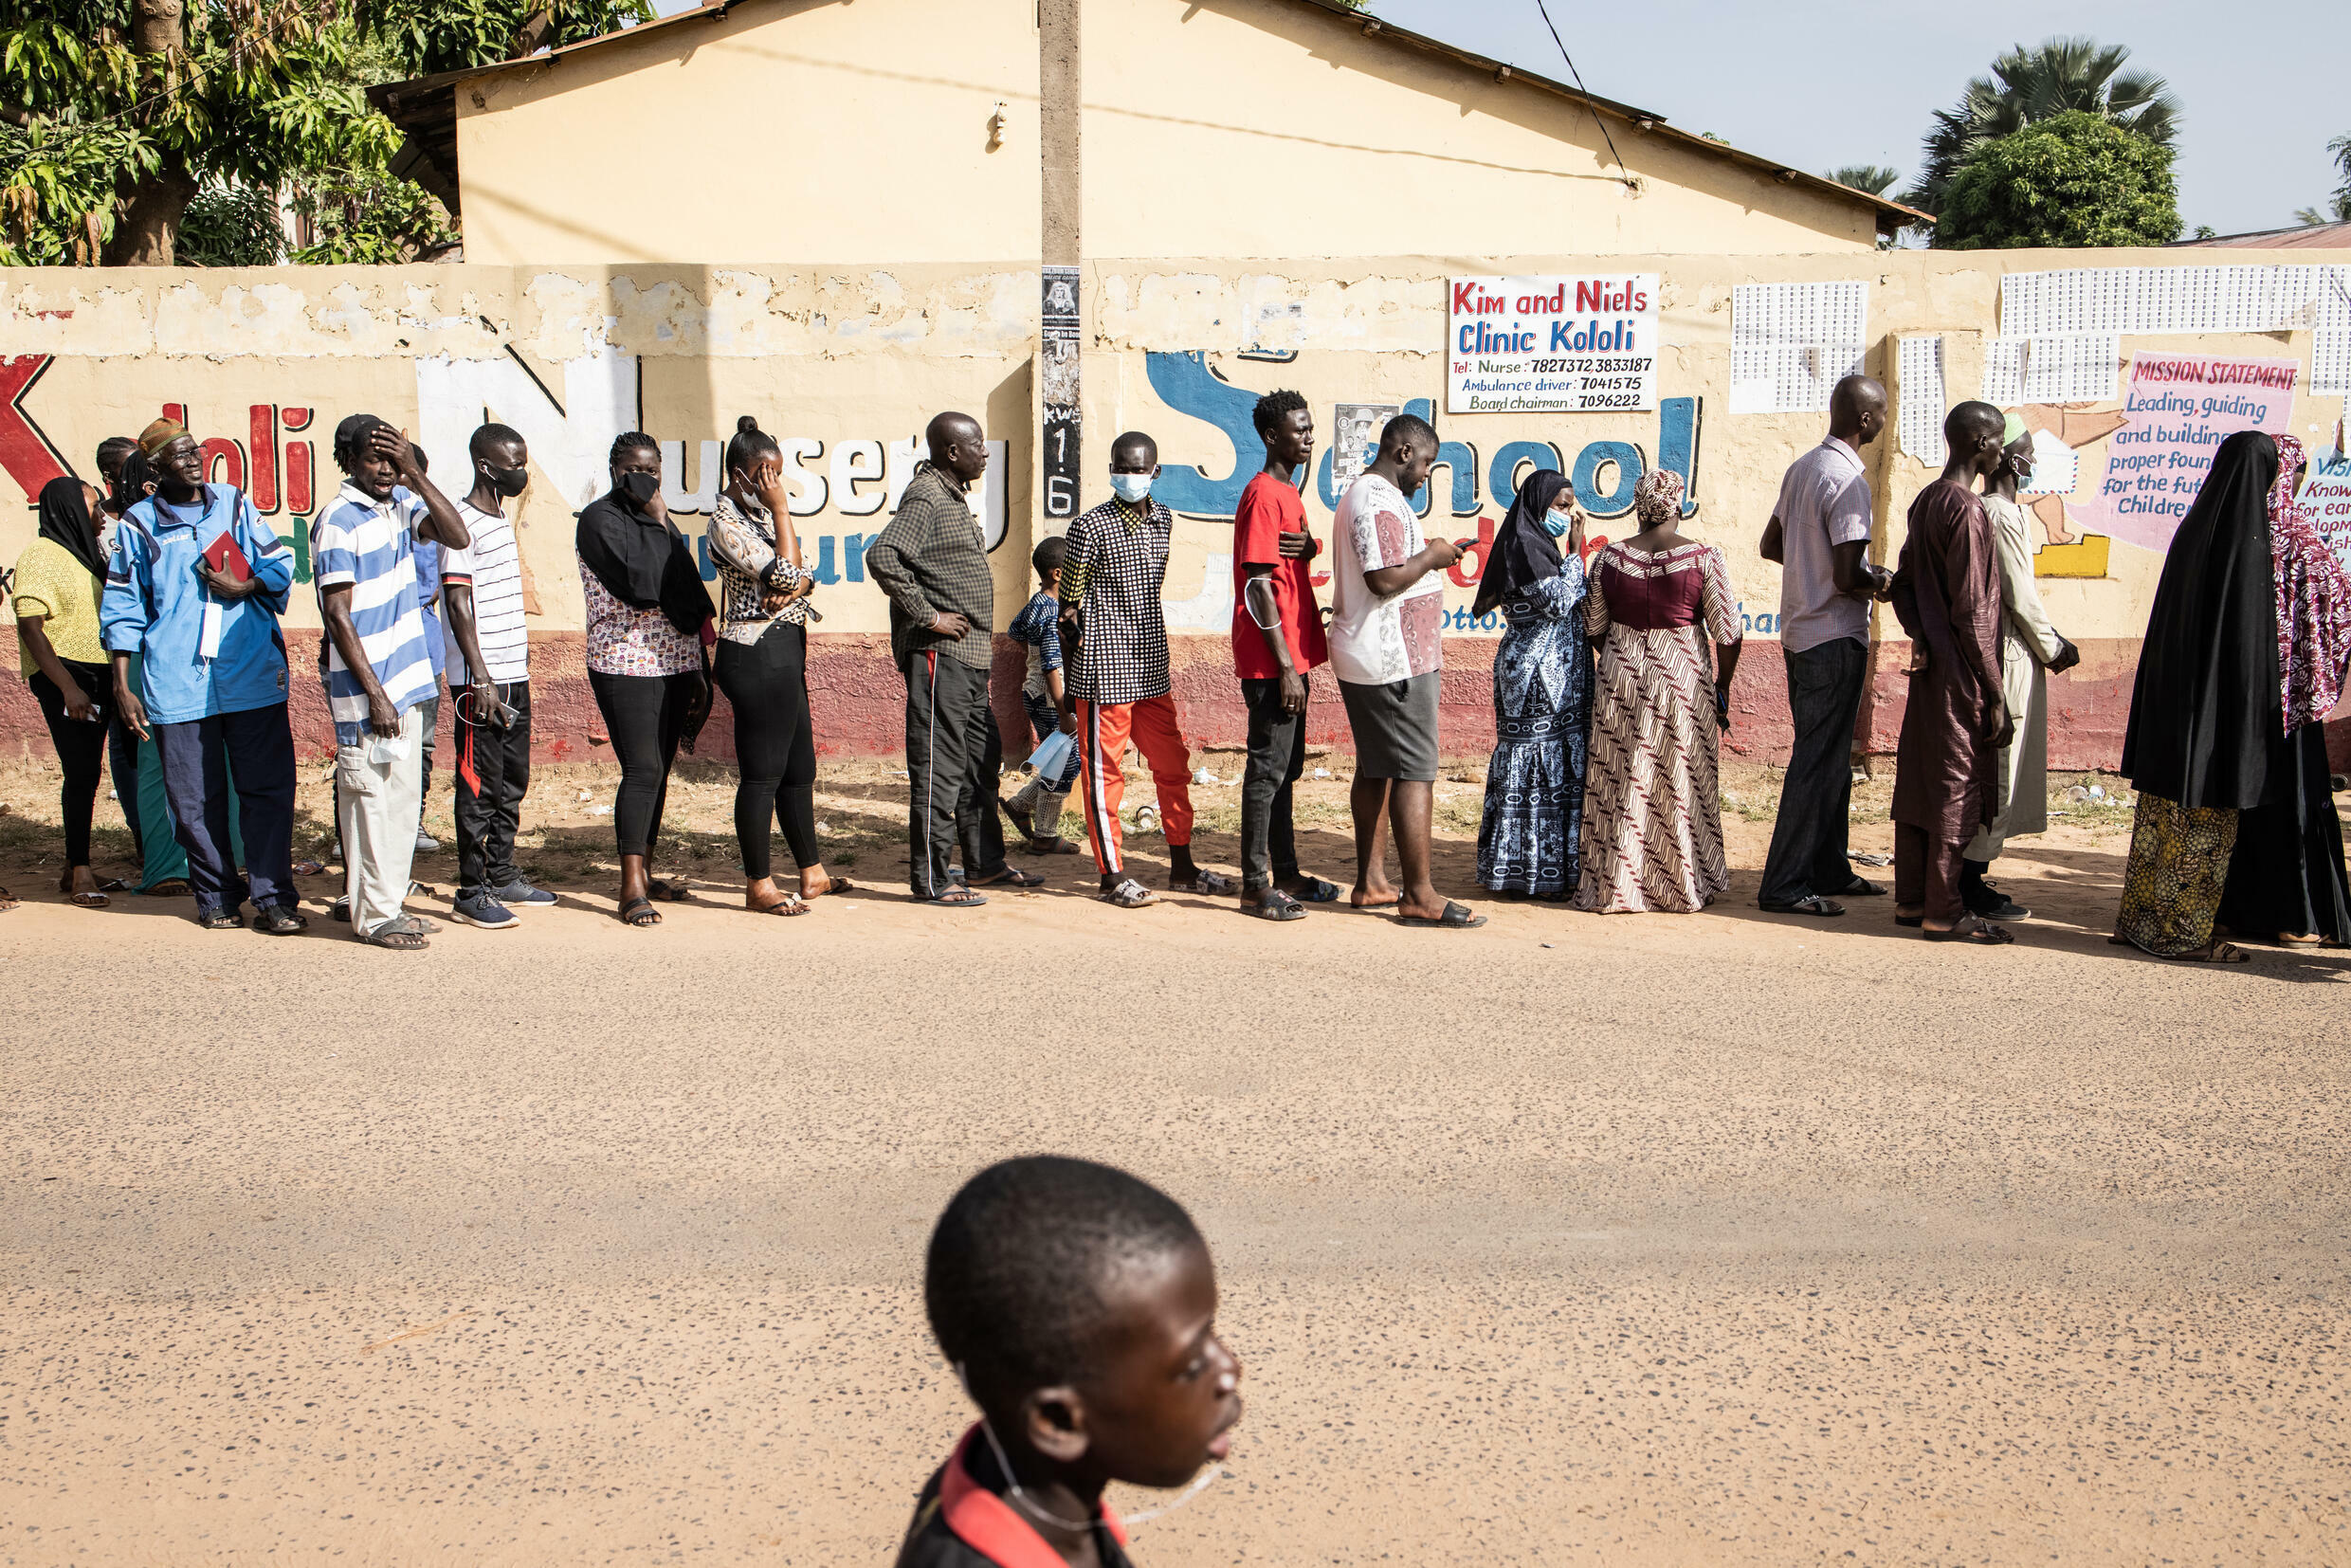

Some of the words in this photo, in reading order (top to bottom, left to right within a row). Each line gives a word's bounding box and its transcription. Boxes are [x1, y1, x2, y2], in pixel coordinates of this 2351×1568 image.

[1453, 282, 1505, 315] Kim
[1516, 283, 1565, 315] and
[1576, 280, 1648, 313] Niels
[1459, 320, 1537, 355] Clinic
[1550, 319, 1635, 353] Kololi
[1453, 361, 1472, 374] Tel:
[2133, 360, 2207, 383] MISSION
[1462, 378, 1532, 392] Ambulance
[1580, 376, 1642, 390] 7041575
[1469, 395, 1508, 410] Board
[1578, 393, 1641, 408] 7096222
[2200, 394, 2268, 425] guiding
[1146, 345, 1703, 523] Shool
[2116, 424, 2152, 445] and
[2108, 452, 2166, 474] proper
[2168, 450, 2212, 469] foun
[2103, 477, 2133, 496] for
[2137, 474, 2168, 491] the
[2173, 476, 2201, 496] fut
[2118, 495, 2191, 518] Childre
